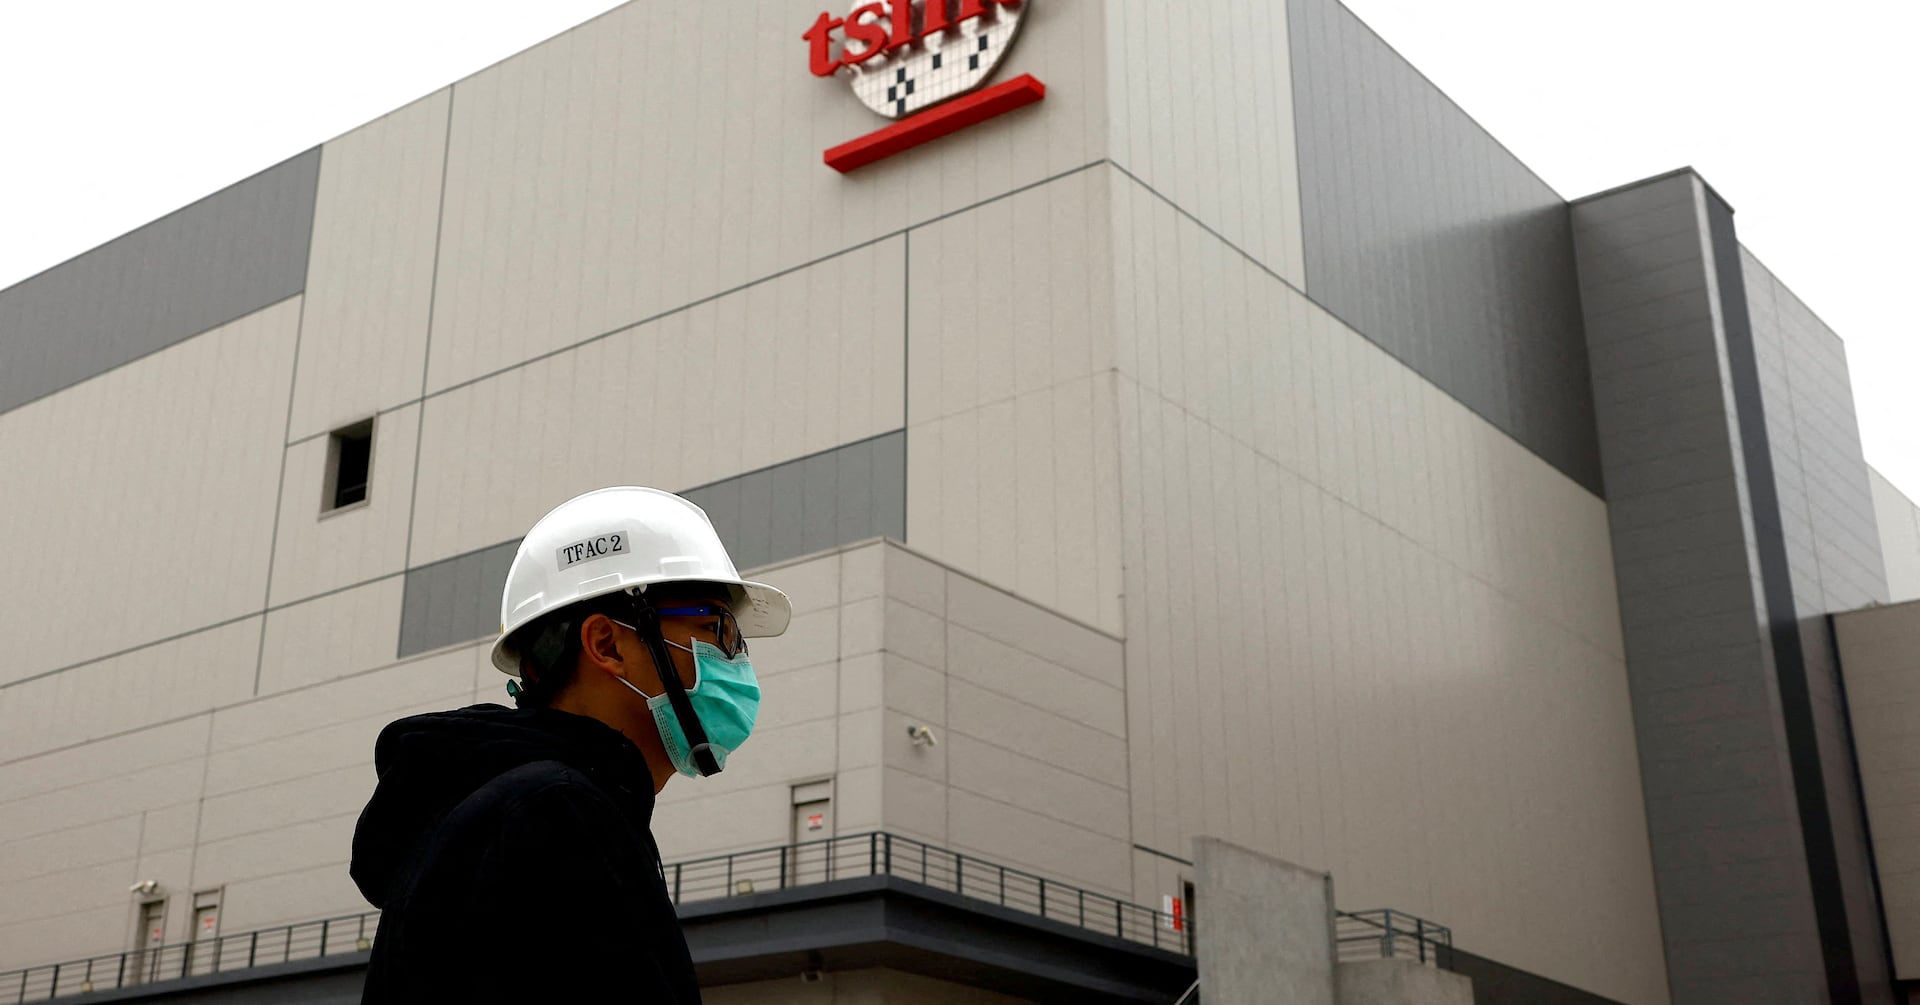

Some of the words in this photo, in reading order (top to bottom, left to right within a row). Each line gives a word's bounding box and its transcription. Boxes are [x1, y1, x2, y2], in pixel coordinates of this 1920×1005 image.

[803, 0, 1022, 77] tsm
[563, 537, 608, 564] TFAC
[610, 534, 622, 552] 2
